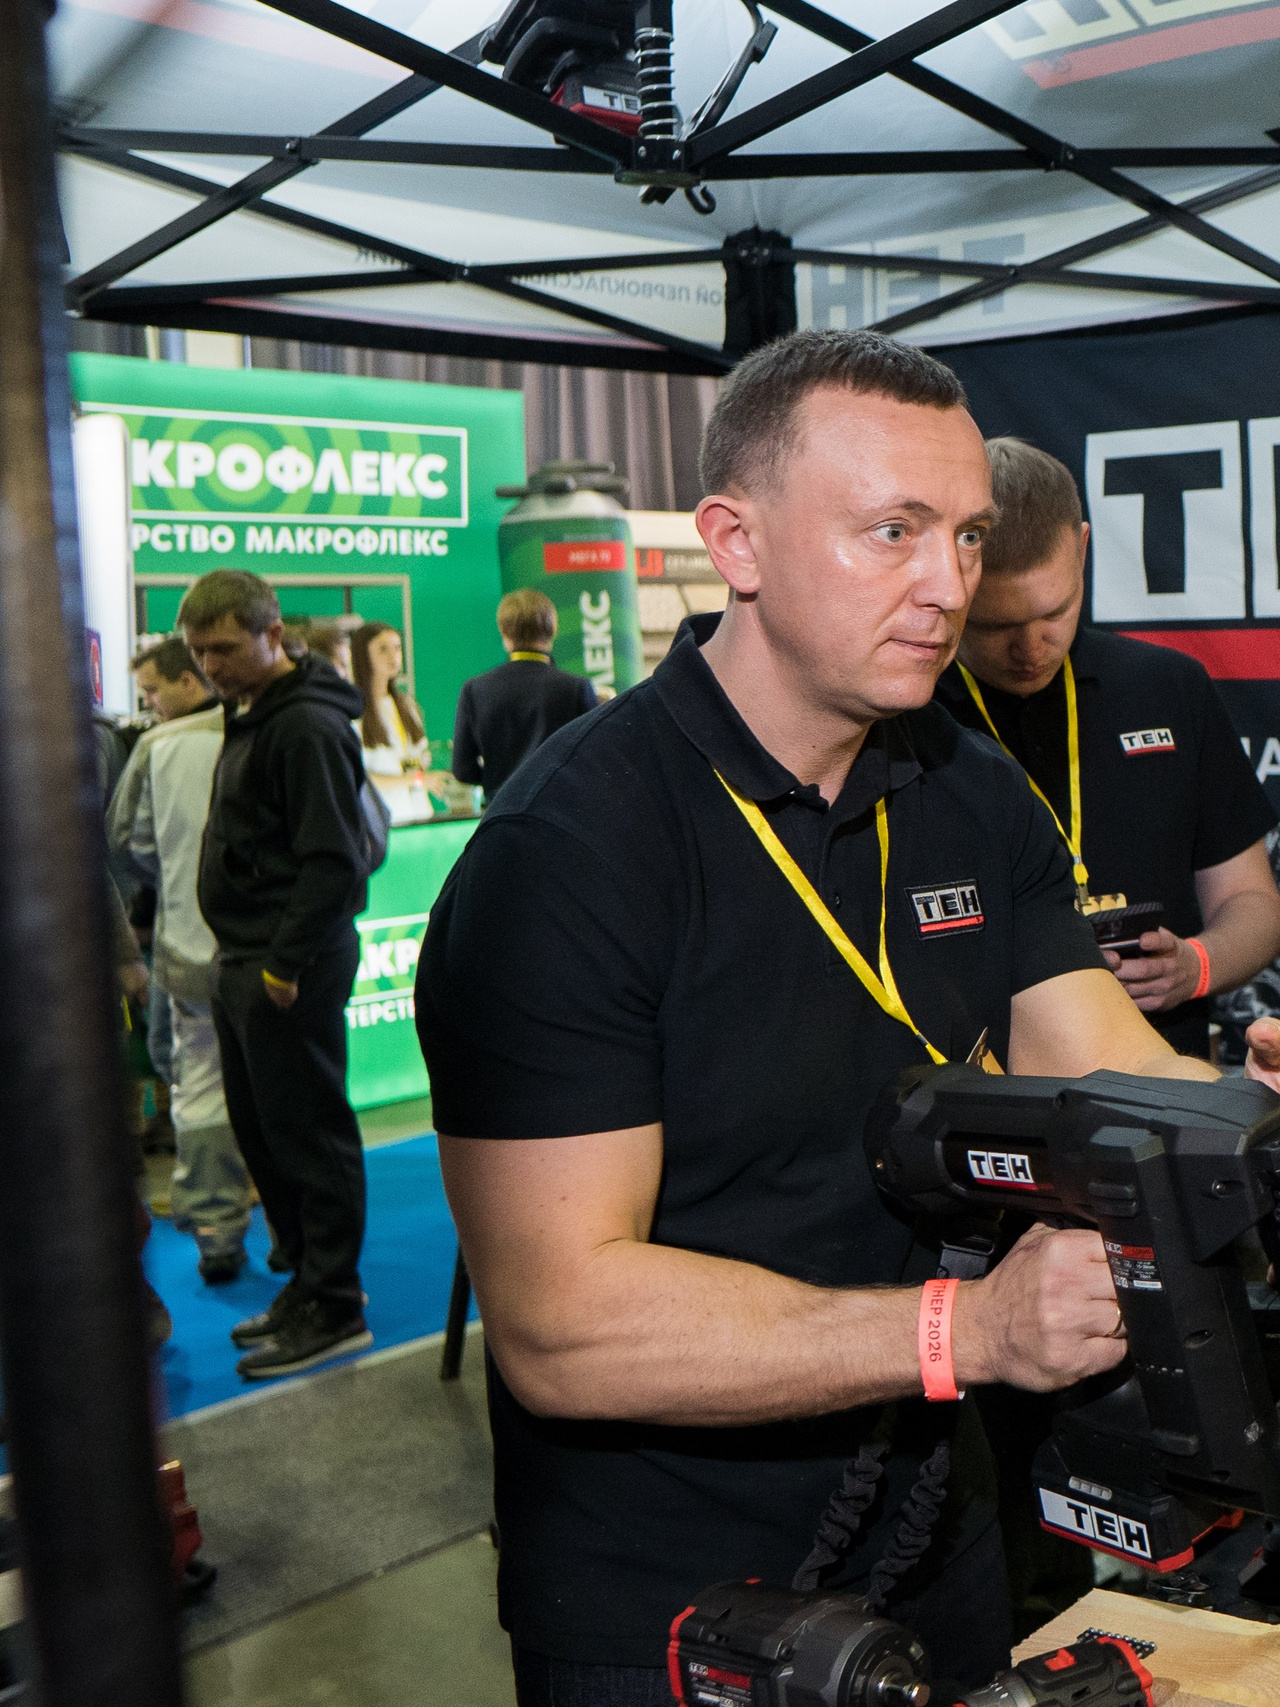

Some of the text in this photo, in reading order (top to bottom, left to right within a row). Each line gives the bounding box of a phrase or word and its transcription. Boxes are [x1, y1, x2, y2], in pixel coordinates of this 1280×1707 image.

[131, 437, 449, 500] КРОФЛЕКС
[132, 522, 449, 556] РСТВО МАКРОФЛЕКС
[927, 1319, 942, 1362] 2026
